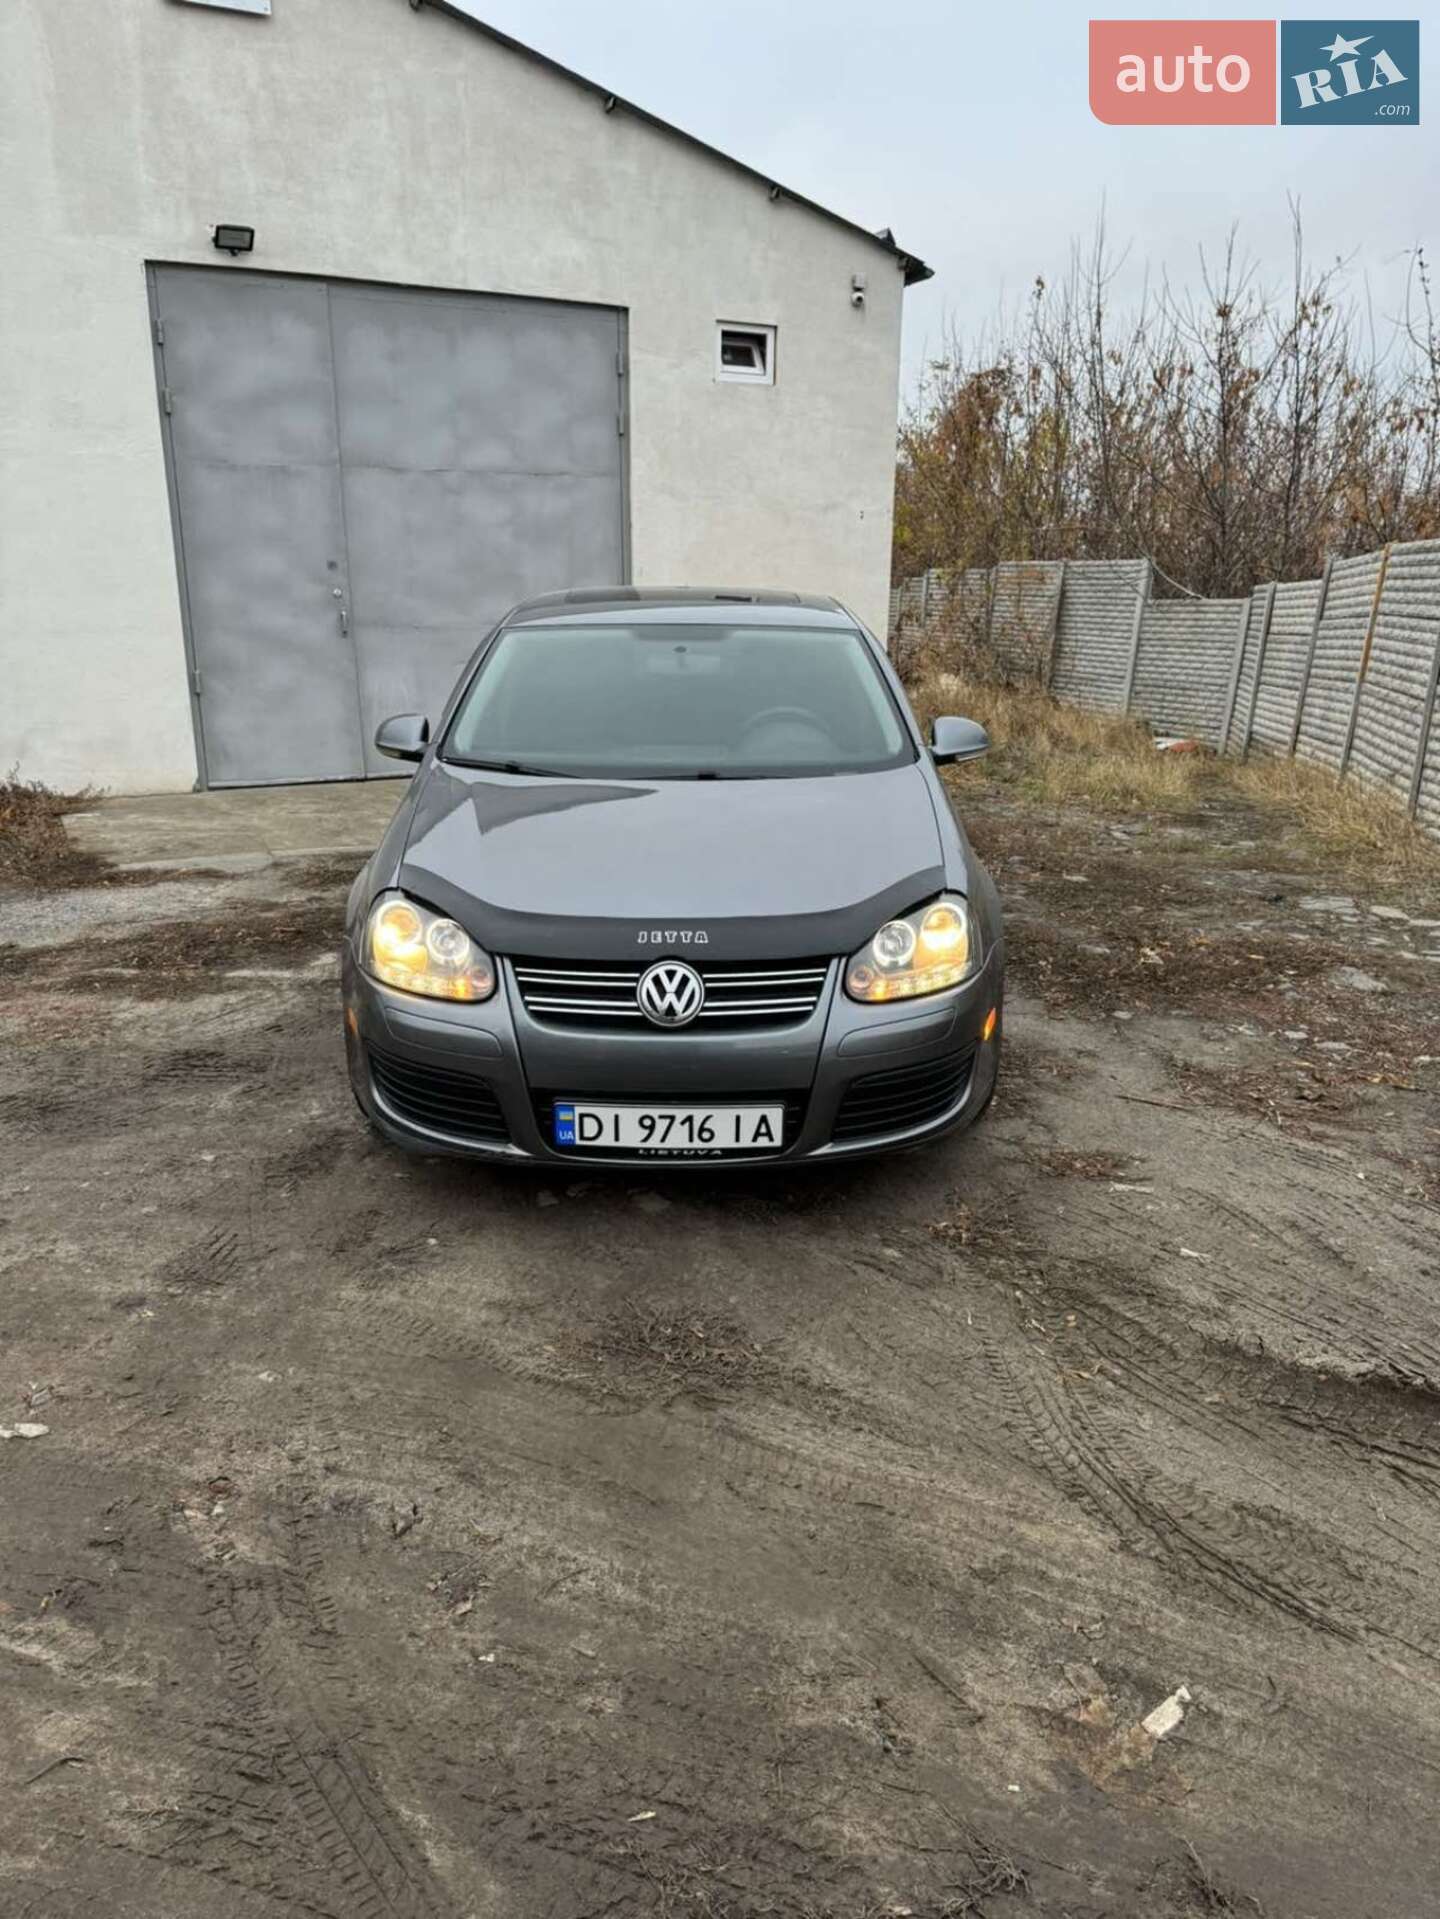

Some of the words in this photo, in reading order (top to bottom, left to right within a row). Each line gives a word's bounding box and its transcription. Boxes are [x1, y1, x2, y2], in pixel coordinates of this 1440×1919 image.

[637, 930, 709, 944] JETTA
[640, 962, 702, 1025] VW
[559, 1130, 574, 1140] UA
[578, 1112, 620, 1142] DI
[638, 1114, 715, 1143] 9716
[734, 1114, 775, 1143] IA
